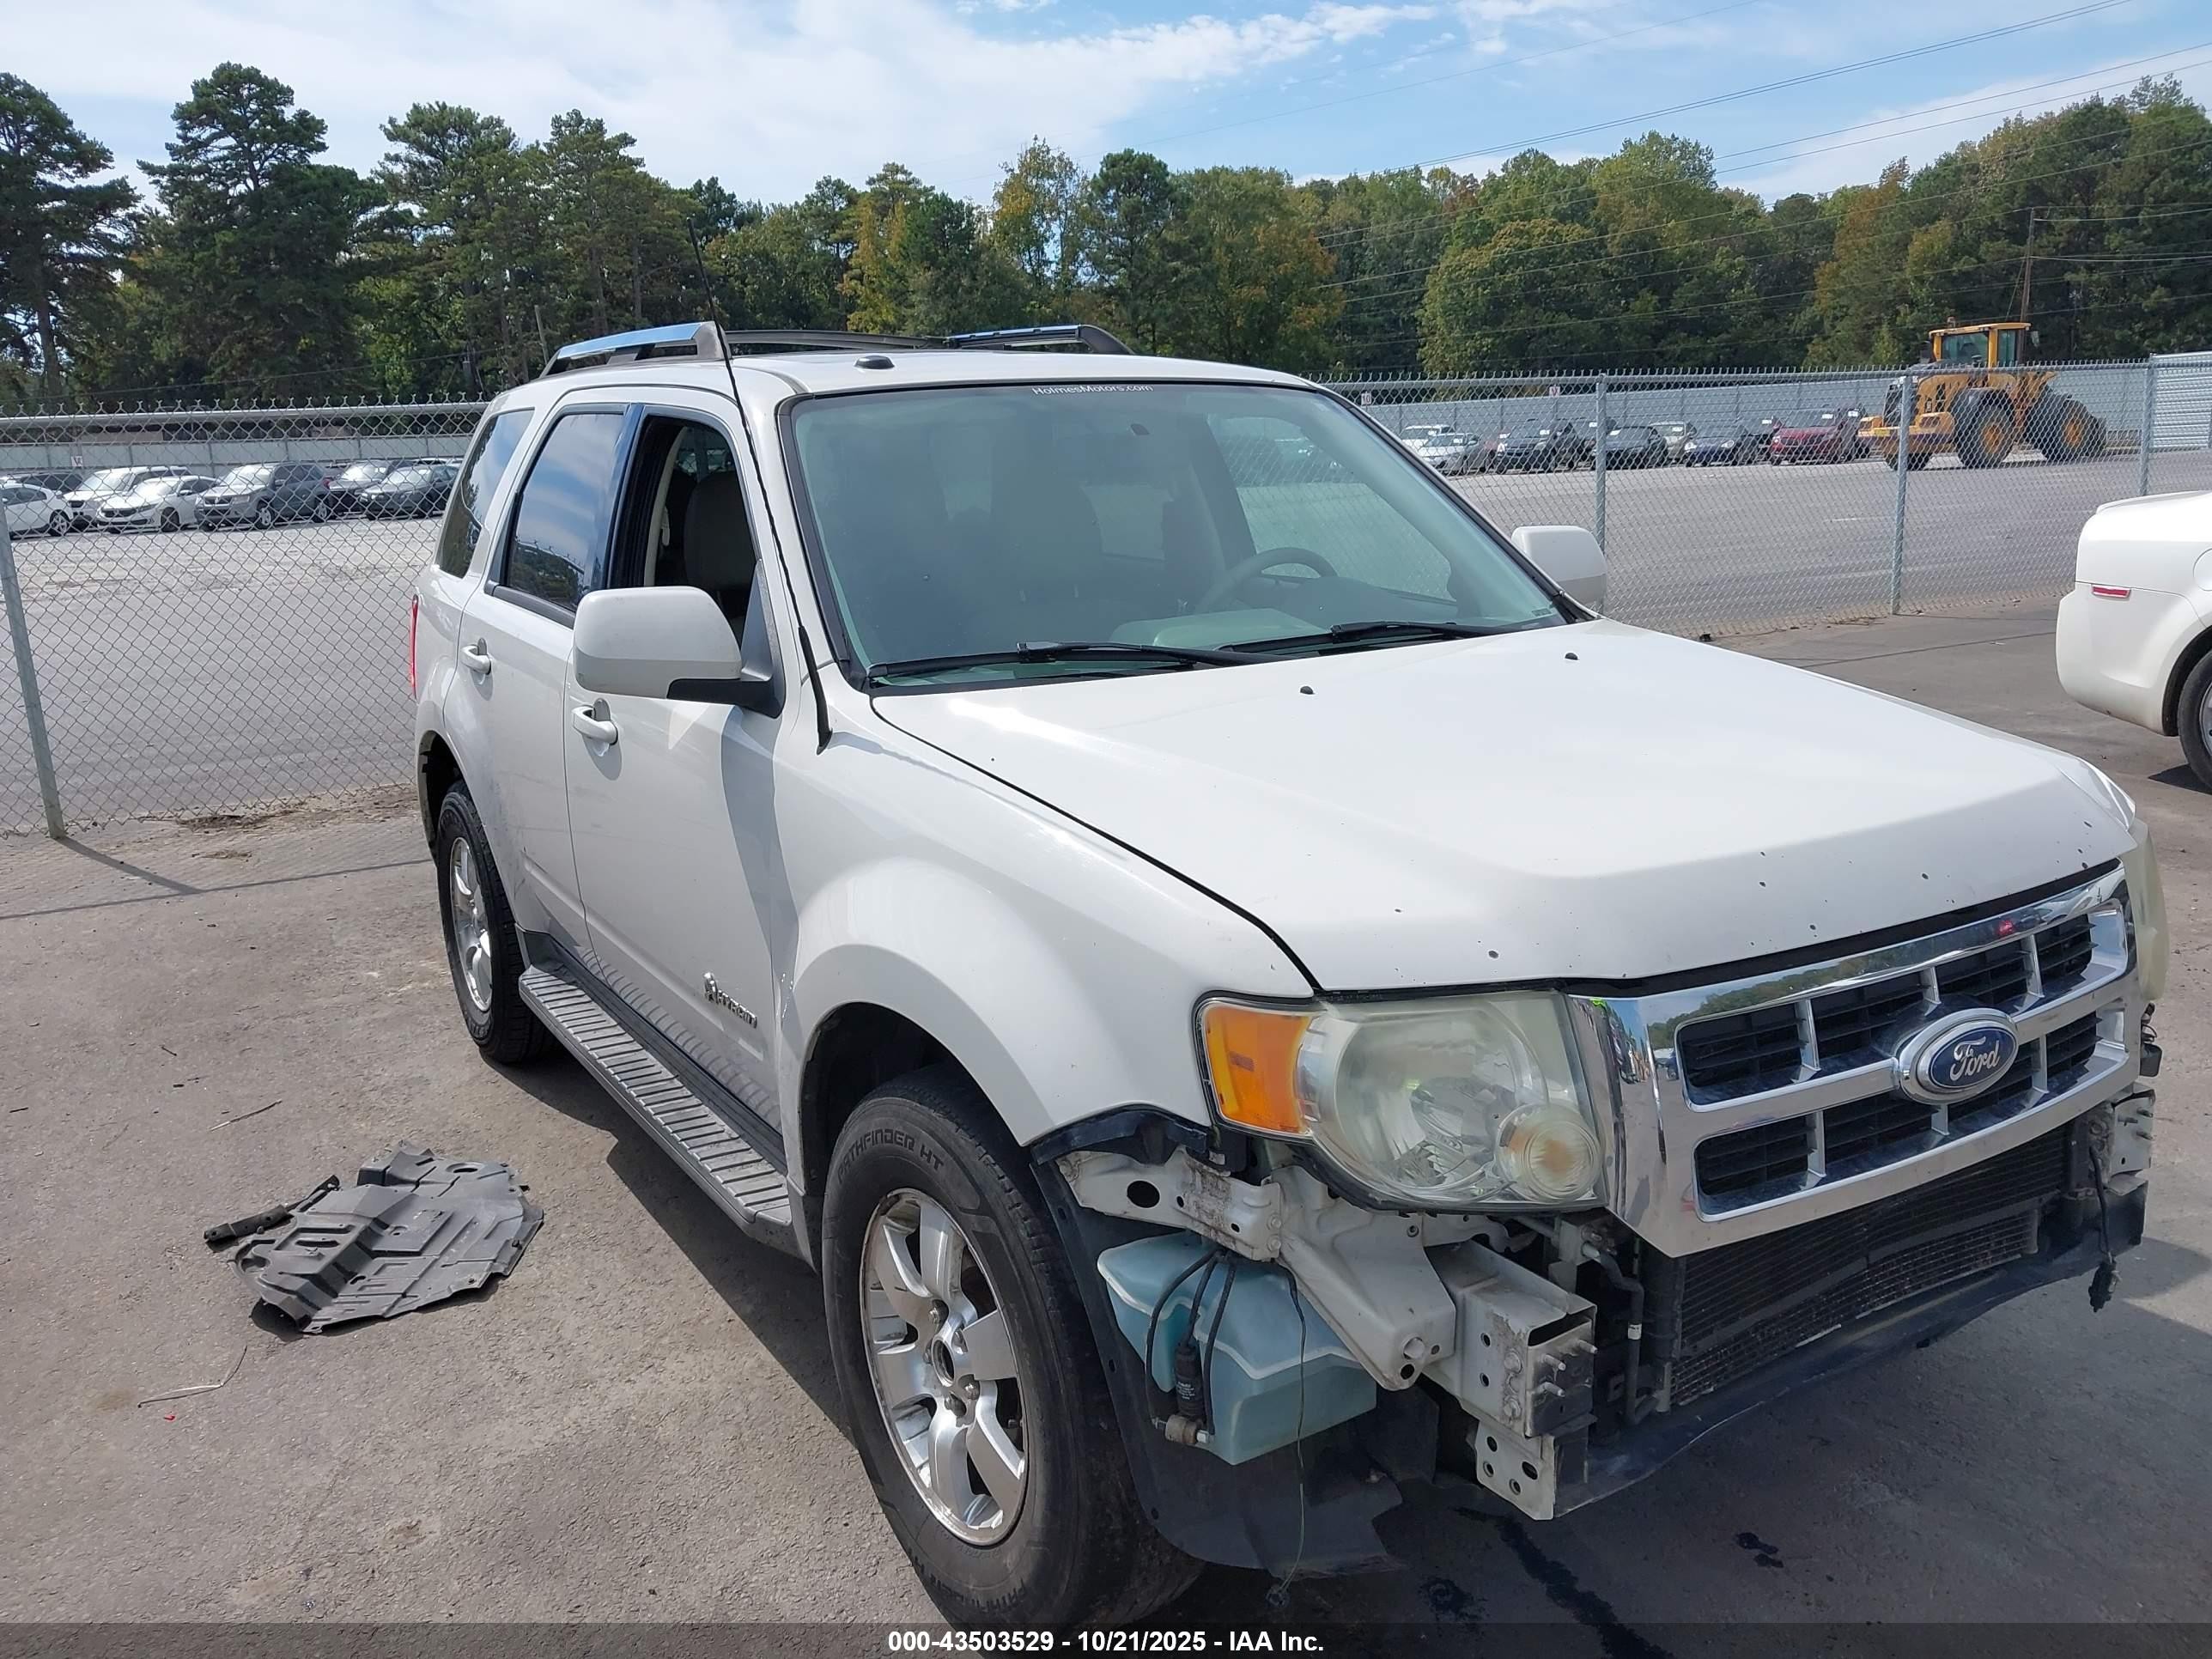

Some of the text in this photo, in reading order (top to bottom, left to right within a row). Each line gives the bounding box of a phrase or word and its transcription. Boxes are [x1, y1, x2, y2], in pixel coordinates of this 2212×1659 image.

[1031, 385, 1154, 396] HolmesMotors.com
[1949, 1036, 2002, 1082] Ford
[836, 1127, 945, 1185] PATHFINDER HT
